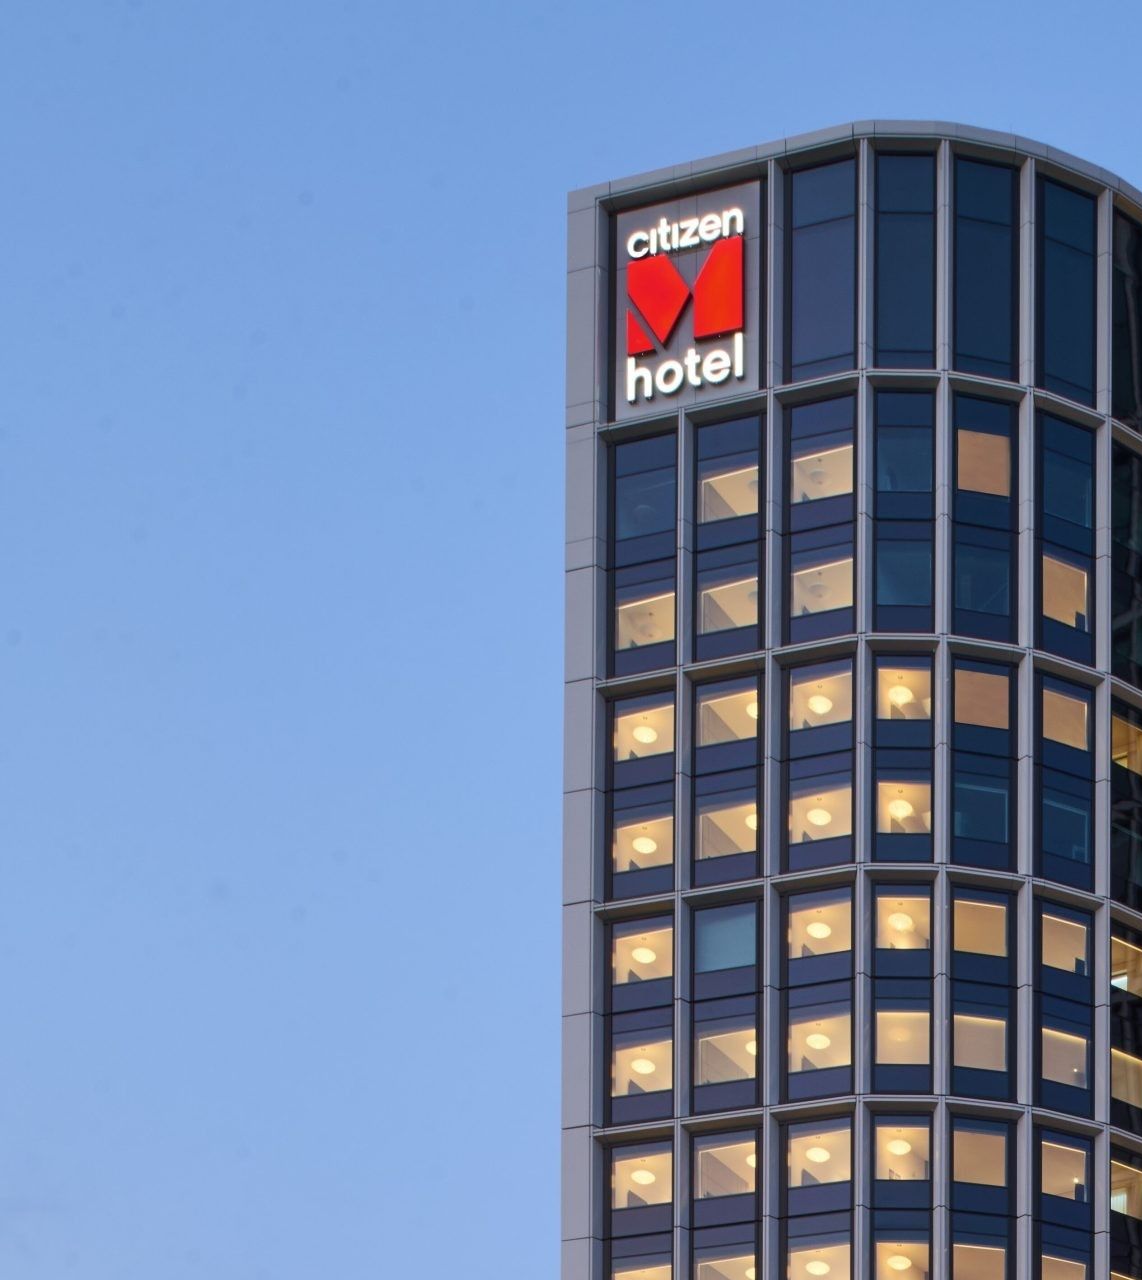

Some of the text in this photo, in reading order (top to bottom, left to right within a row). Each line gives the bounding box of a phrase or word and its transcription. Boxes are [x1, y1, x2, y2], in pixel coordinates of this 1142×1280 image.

[627, 208, 744, 258] citizen
[627, 235, 743, 355] M
[627, 332, 744, 402] hotel
